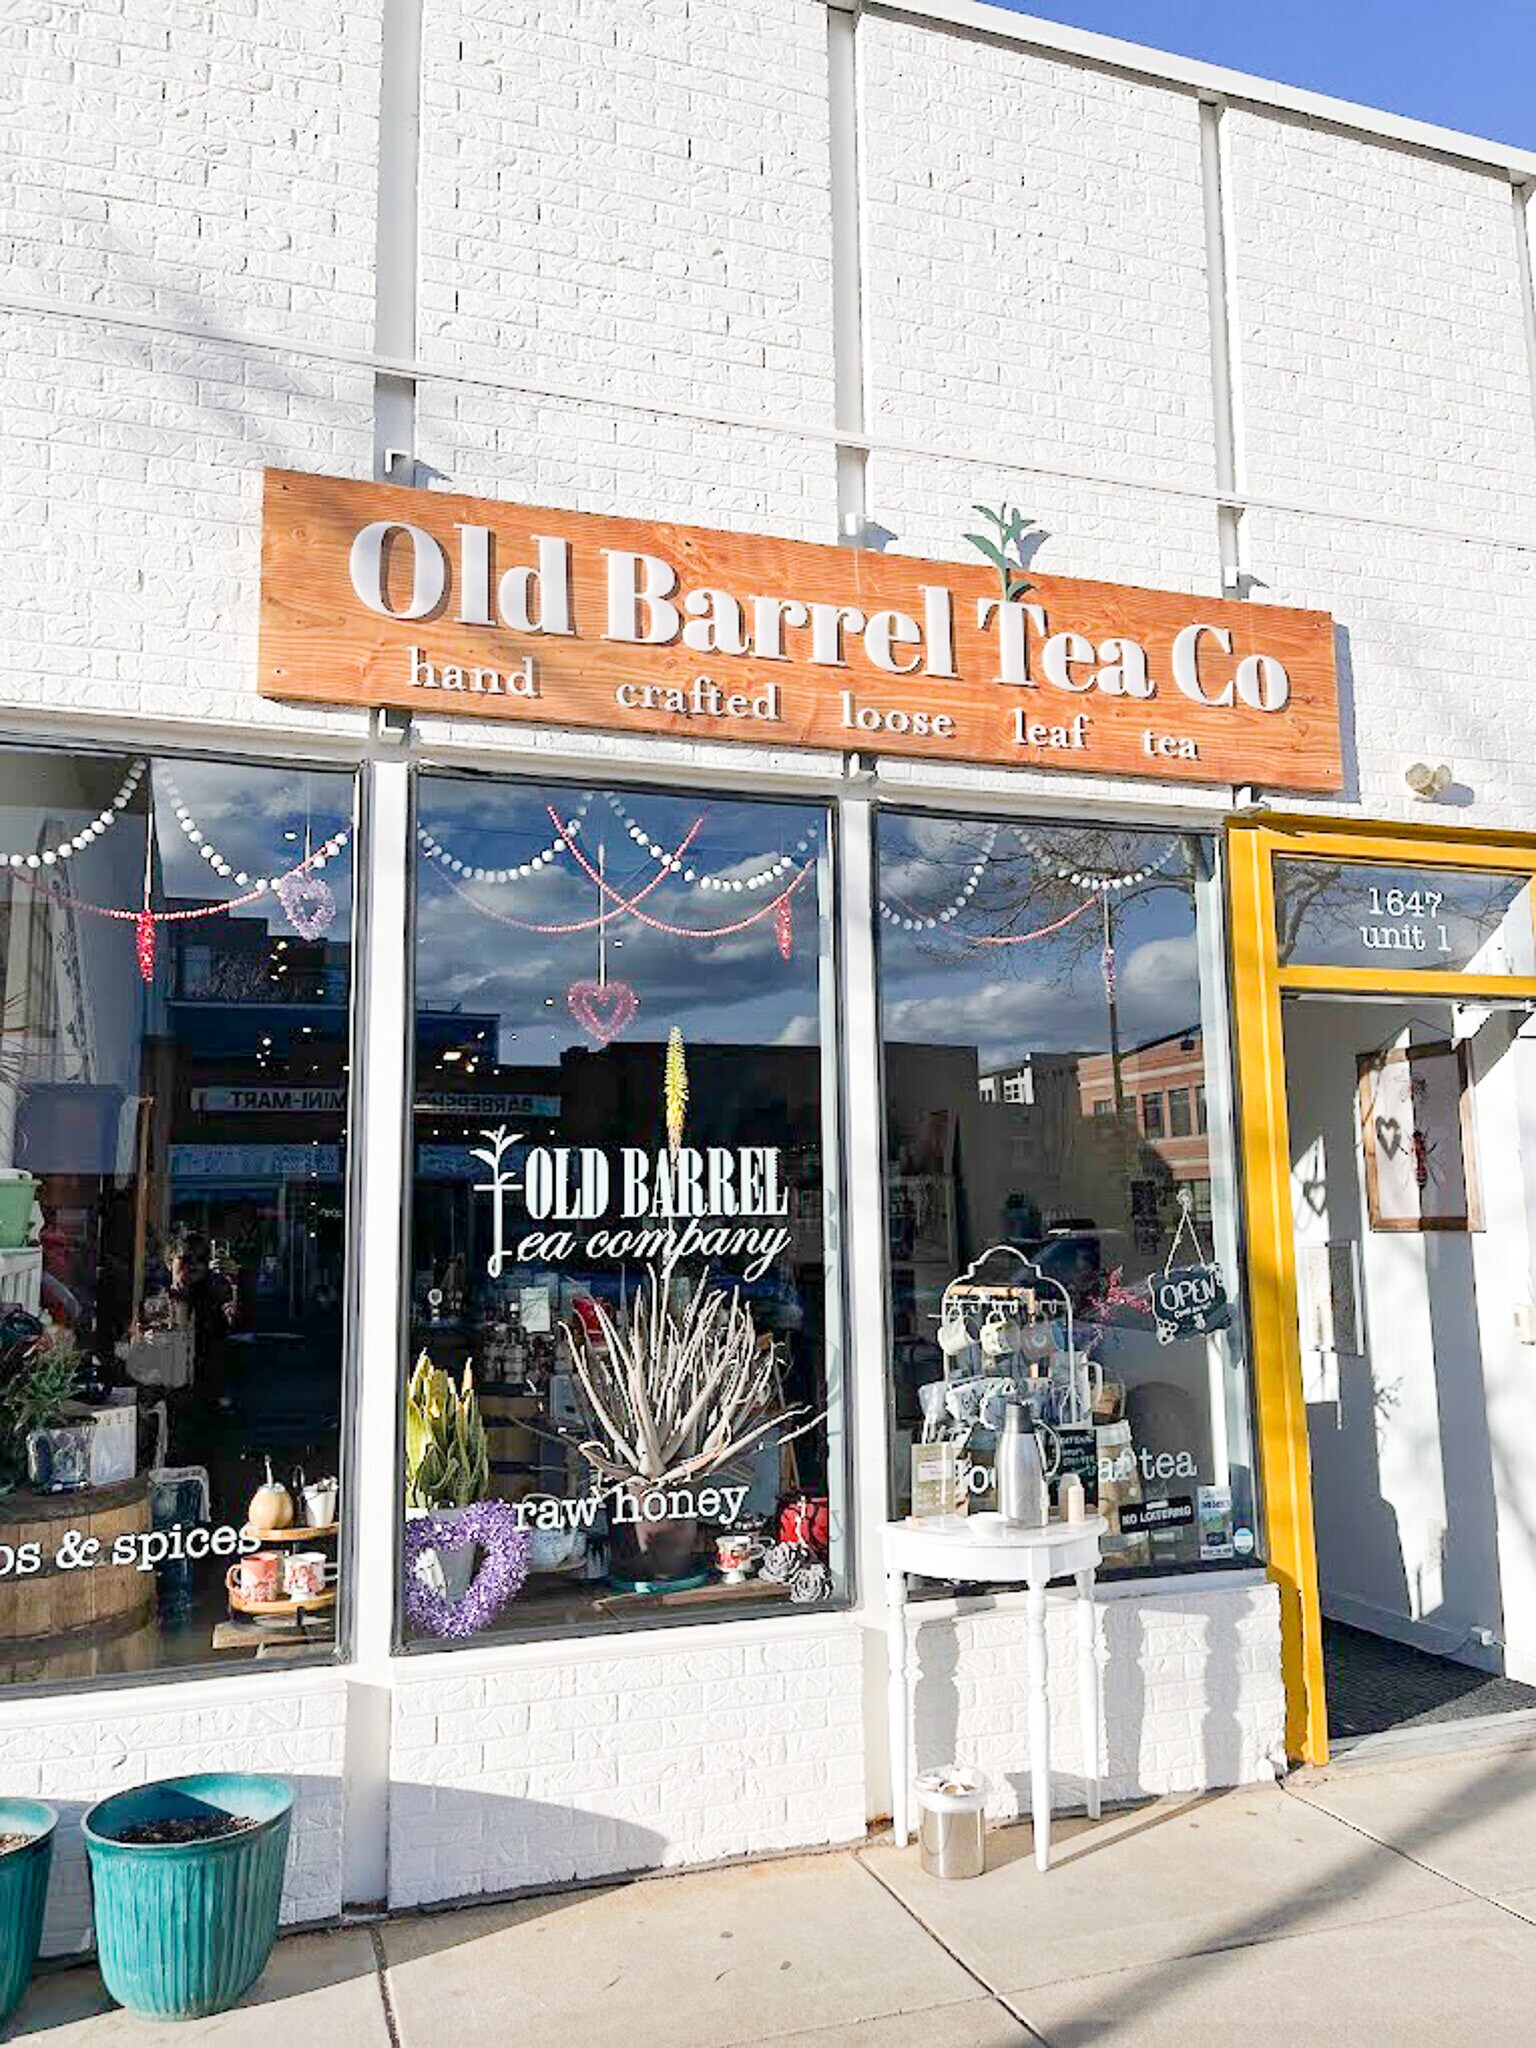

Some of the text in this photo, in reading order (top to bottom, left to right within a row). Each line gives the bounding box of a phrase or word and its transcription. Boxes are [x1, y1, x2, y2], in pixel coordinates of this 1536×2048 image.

[349, 520, 1291, 713] Old Barrel Tea Co
[407, 646, 1199, 761] hand crafted loose leaf tea
[1367, 886, 1443, 919] 1647
[1359, 923, 1452, 952] unit 1
[524, 1146, 789, 1220] OLD BARREL
[585, 1217, 792, 1283] company
[1160, 1275, 1216, 1311] OPEN
[1138, 1447, 1198, 1481] tea
[513, 1484, 749, 1531] raw honey
[55, 1529, 101, 1570] &
[111, 1522, 262, 1571] spices
